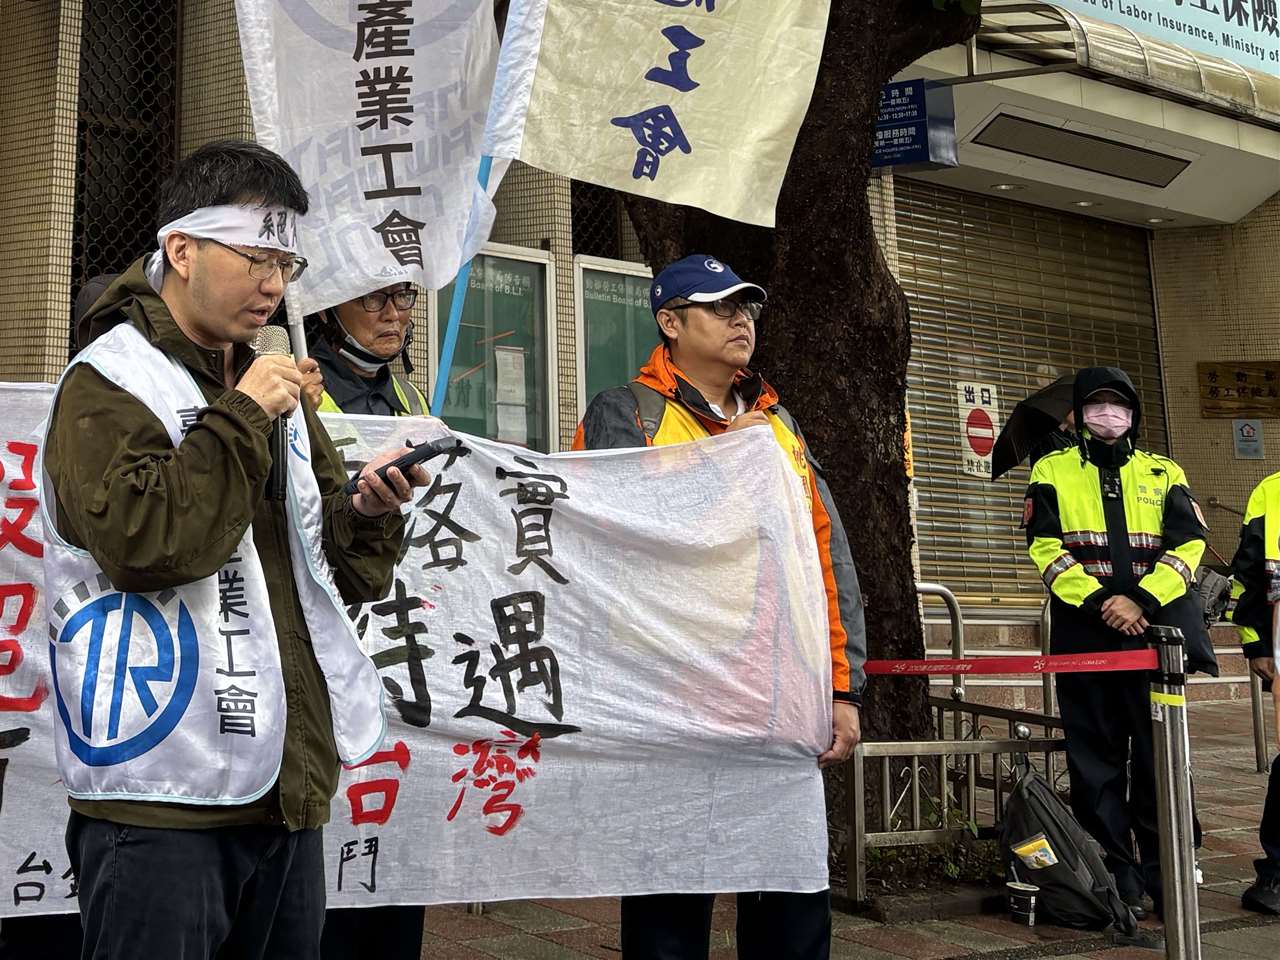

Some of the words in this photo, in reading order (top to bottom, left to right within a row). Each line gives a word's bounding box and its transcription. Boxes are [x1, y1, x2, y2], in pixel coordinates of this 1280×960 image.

[1119, 0, 1153, 24] Labor
[1157, 12, 1218, 46] Insurance,
[1222, 33, 1265, 61] Ministry
[258, 211, 297, 247] 絕
[964, 385, 991, 406] 出口
[214, 548, 259, 738] 業工會
